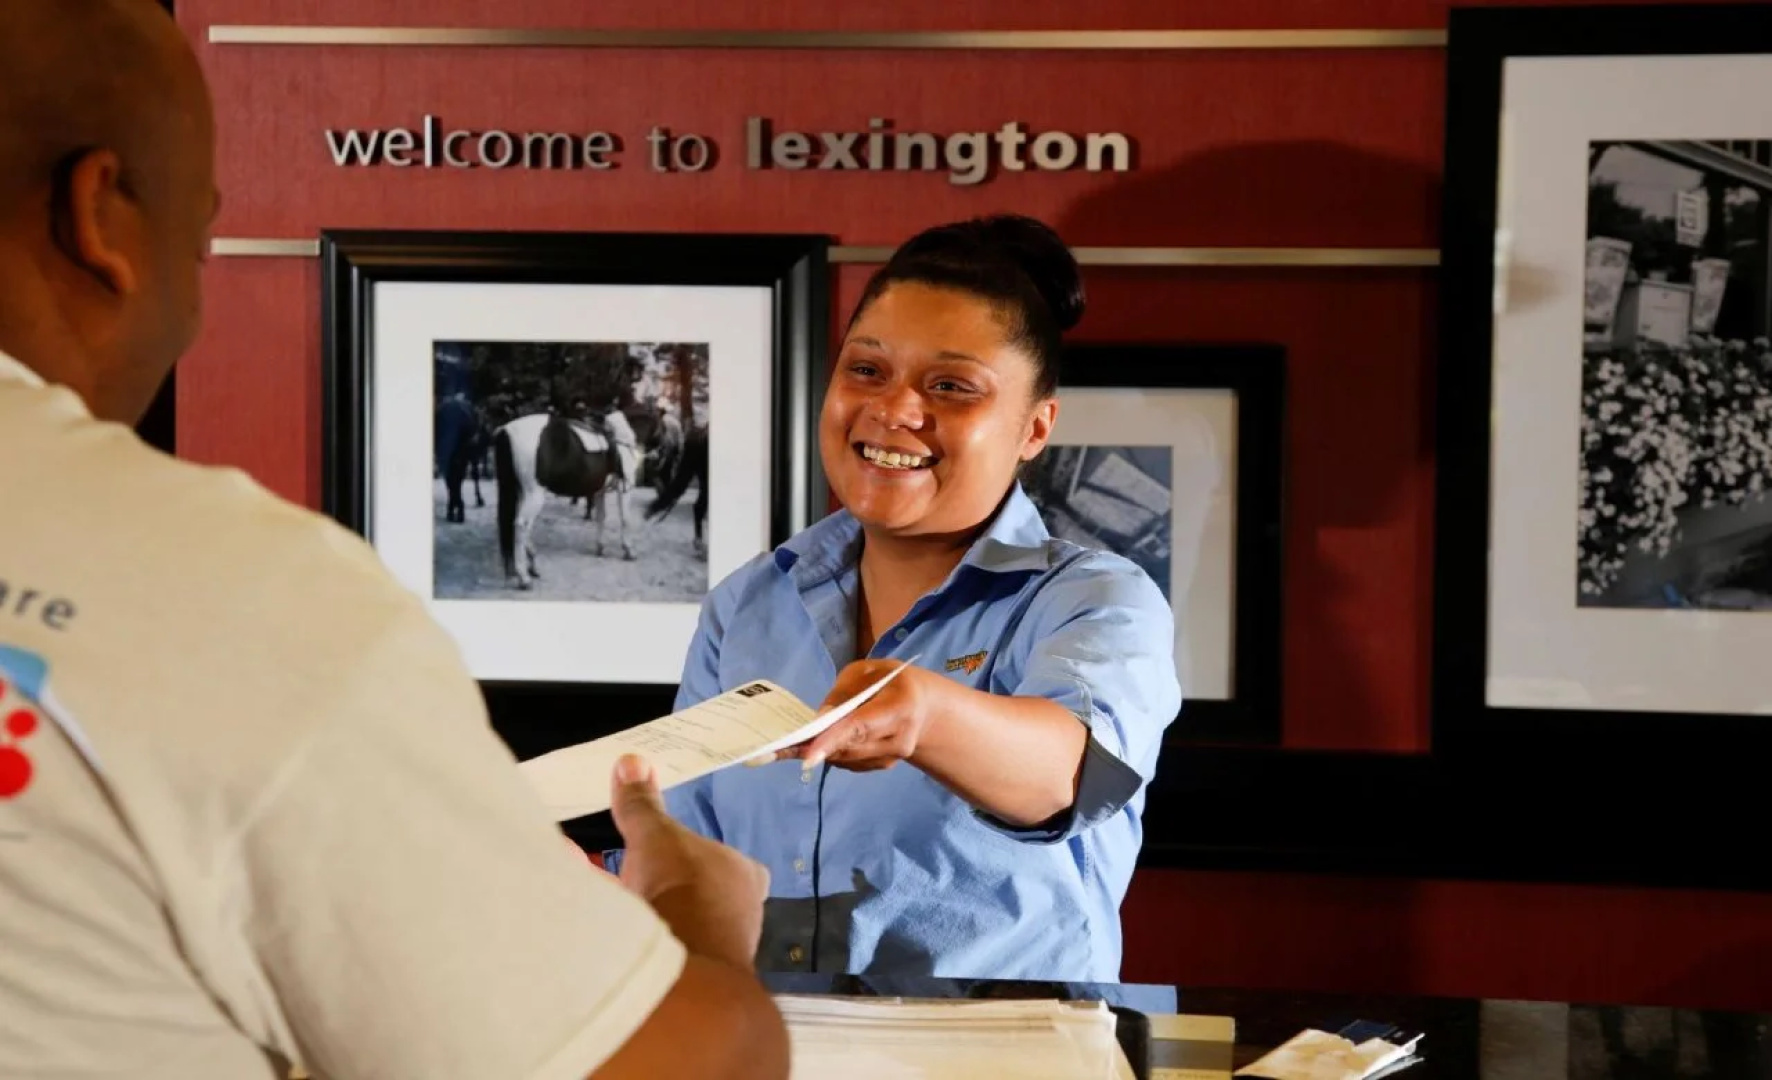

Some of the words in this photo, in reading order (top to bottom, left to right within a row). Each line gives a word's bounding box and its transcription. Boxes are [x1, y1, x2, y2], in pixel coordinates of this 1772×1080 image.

[325, 114, 615, 169] welcome
[647, 126, 709, 173] to
[747, 116, 1129, 185] lexington
